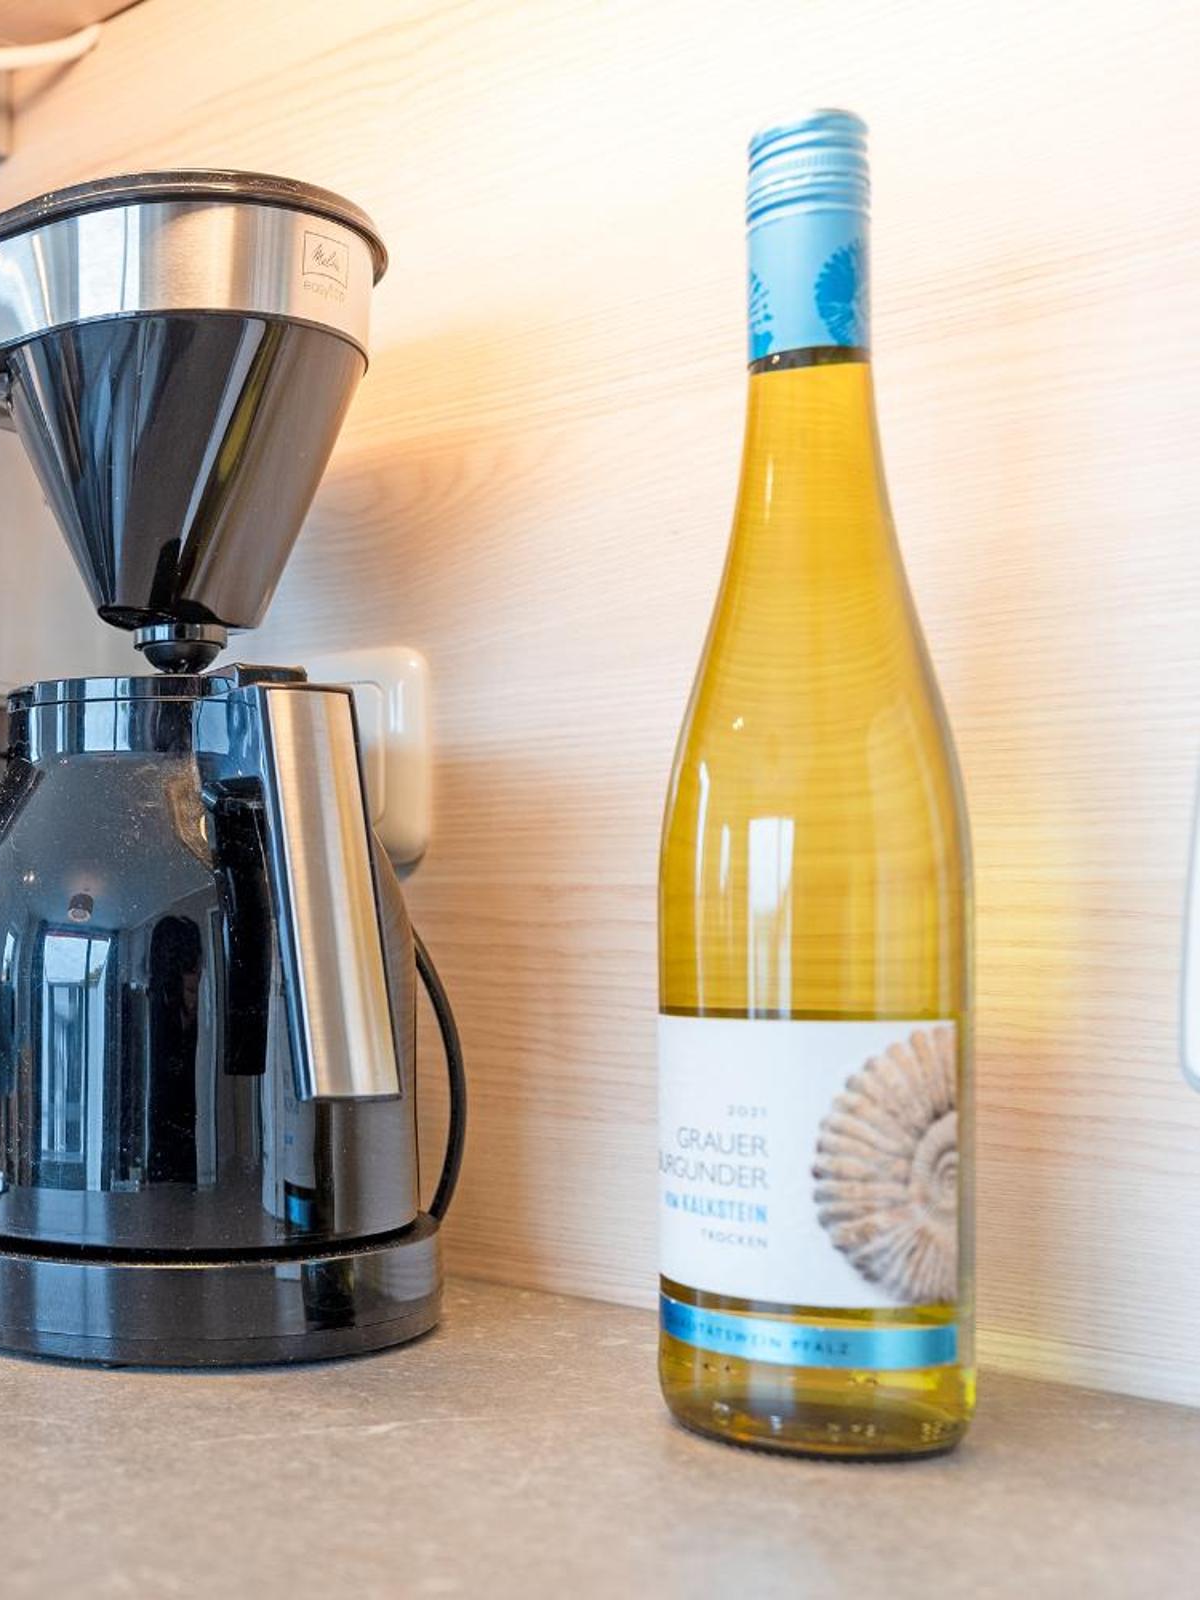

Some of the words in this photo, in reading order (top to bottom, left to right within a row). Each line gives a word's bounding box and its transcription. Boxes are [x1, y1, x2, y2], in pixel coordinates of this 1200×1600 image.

[727, 1104, 768, 1118] 2021
[676, 1126, 769, 1158] GRAUER
[701, 1228, 768, 1248] TROCKEN
[792, 1336, 850, 1356] PFALZ
